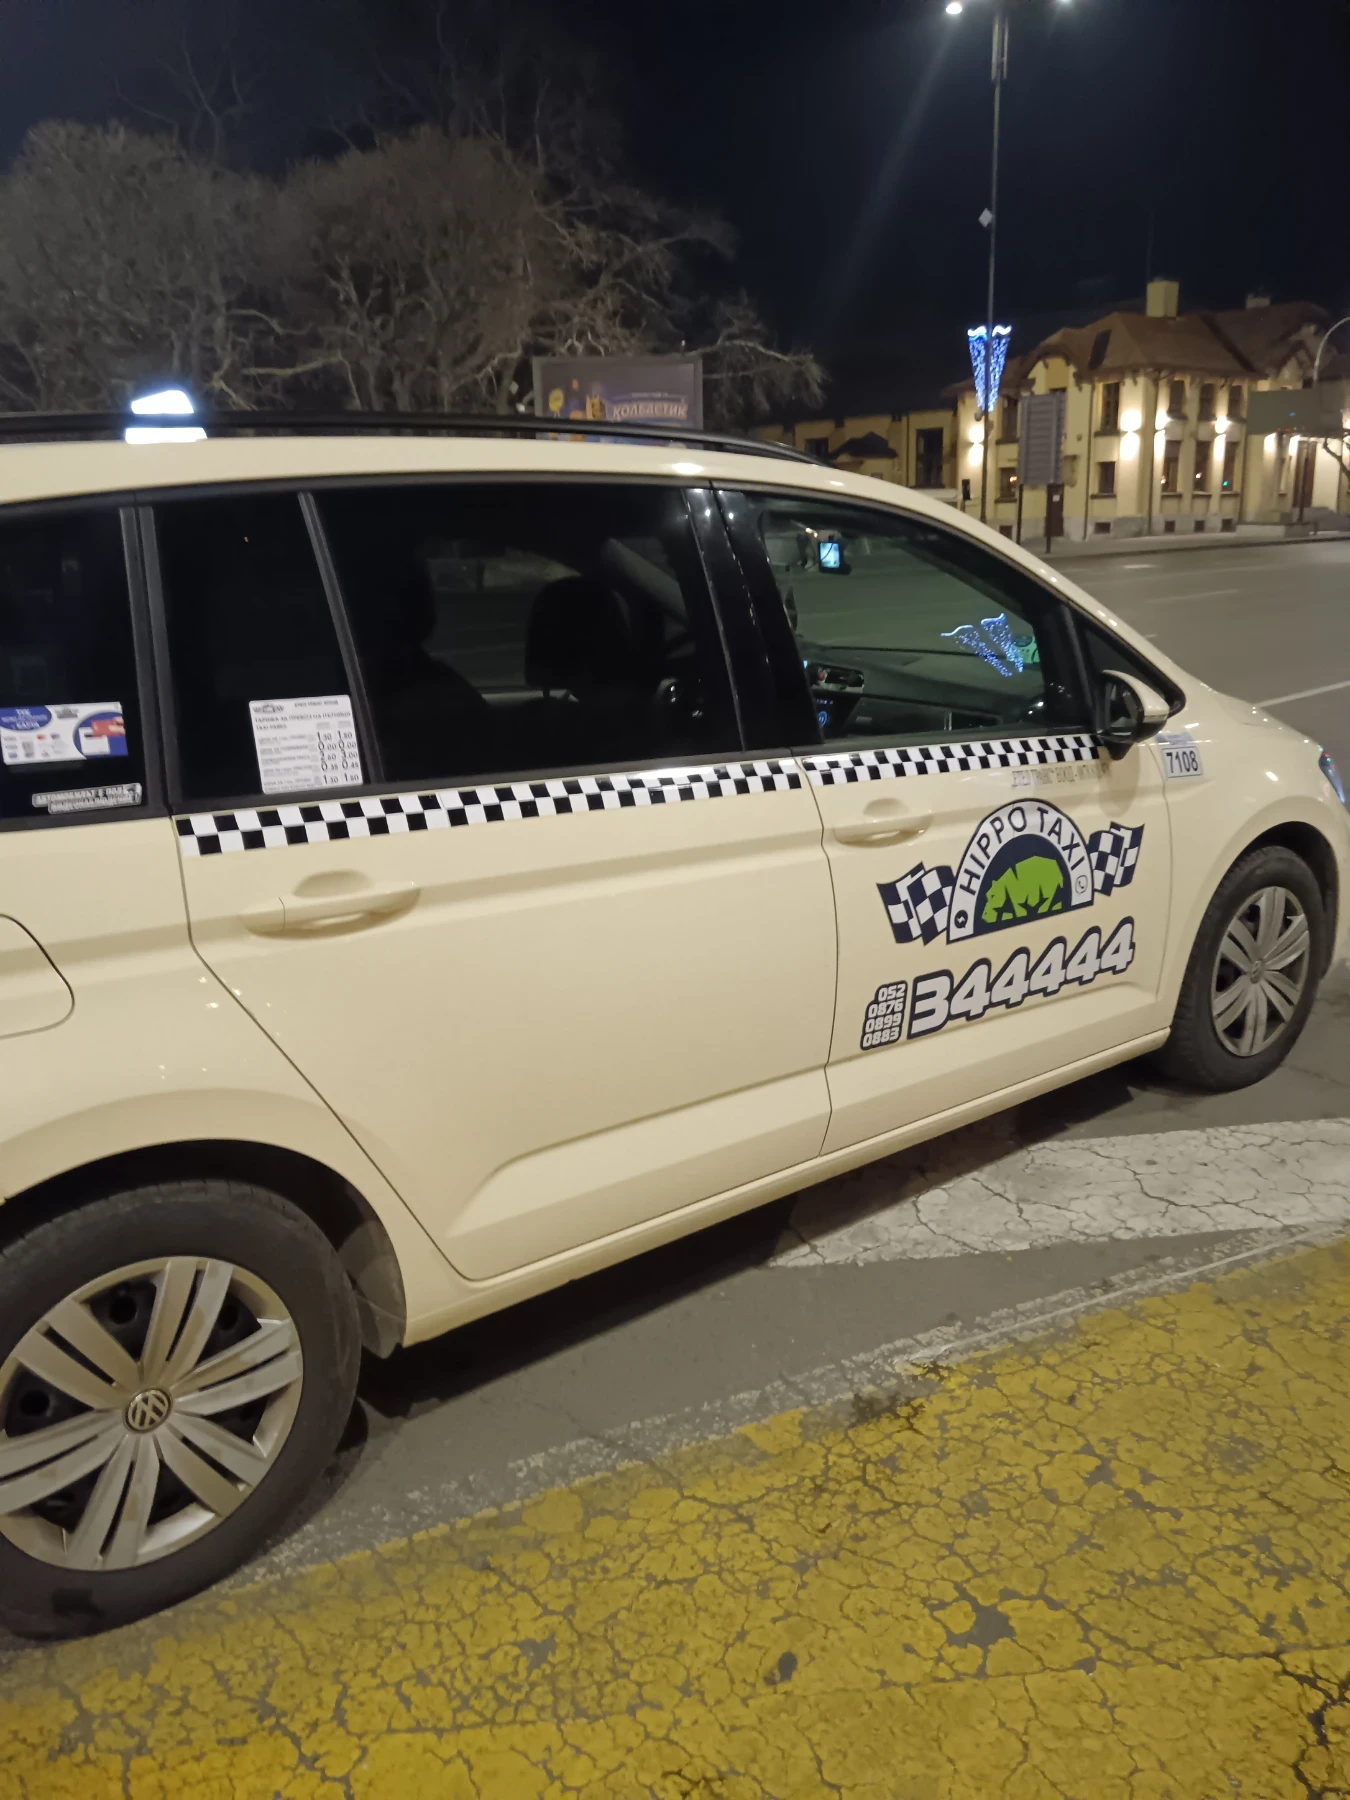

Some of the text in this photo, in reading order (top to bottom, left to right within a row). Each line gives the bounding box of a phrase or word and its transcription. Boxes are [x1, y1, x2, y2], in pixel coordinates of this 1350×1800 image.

[1166, 750, 1198, 773] 7108
[959, 806, 1086, 896] HIPPO TAXI
[908, 917, 1135, 1039] 344444
[877, 983, 906, 1002] 052
[867, 998, 904, 1018] 0876
[865, 1013, 902, 1033] 0899
[862, 1027, 900, 1048] 0883
